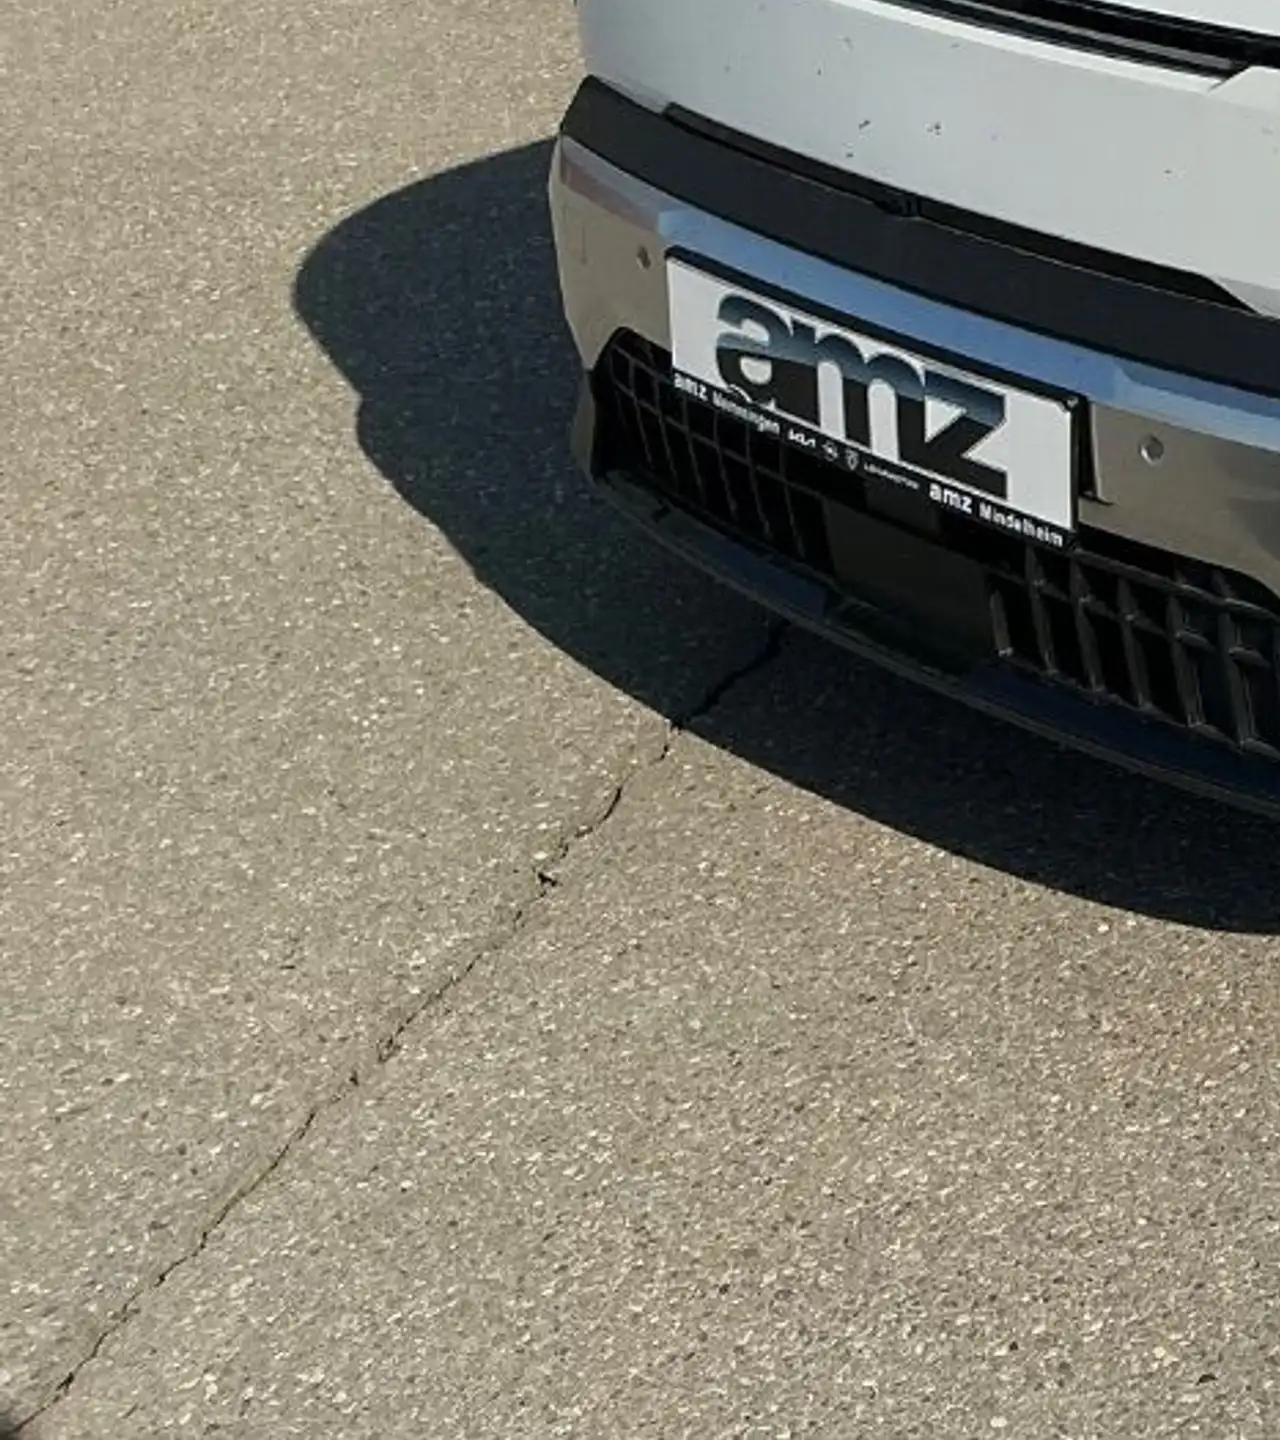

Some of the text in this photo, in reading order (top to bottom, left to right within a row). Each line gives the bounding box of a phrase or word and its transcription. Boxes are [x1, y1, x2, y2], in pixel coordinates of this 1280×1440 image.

[673, 372, 708, 402] amz
[929, 482, 972, 514] amz
[979, 501, 1064, 547] Mindelheim
[715, 293, 1008, 500] amz
